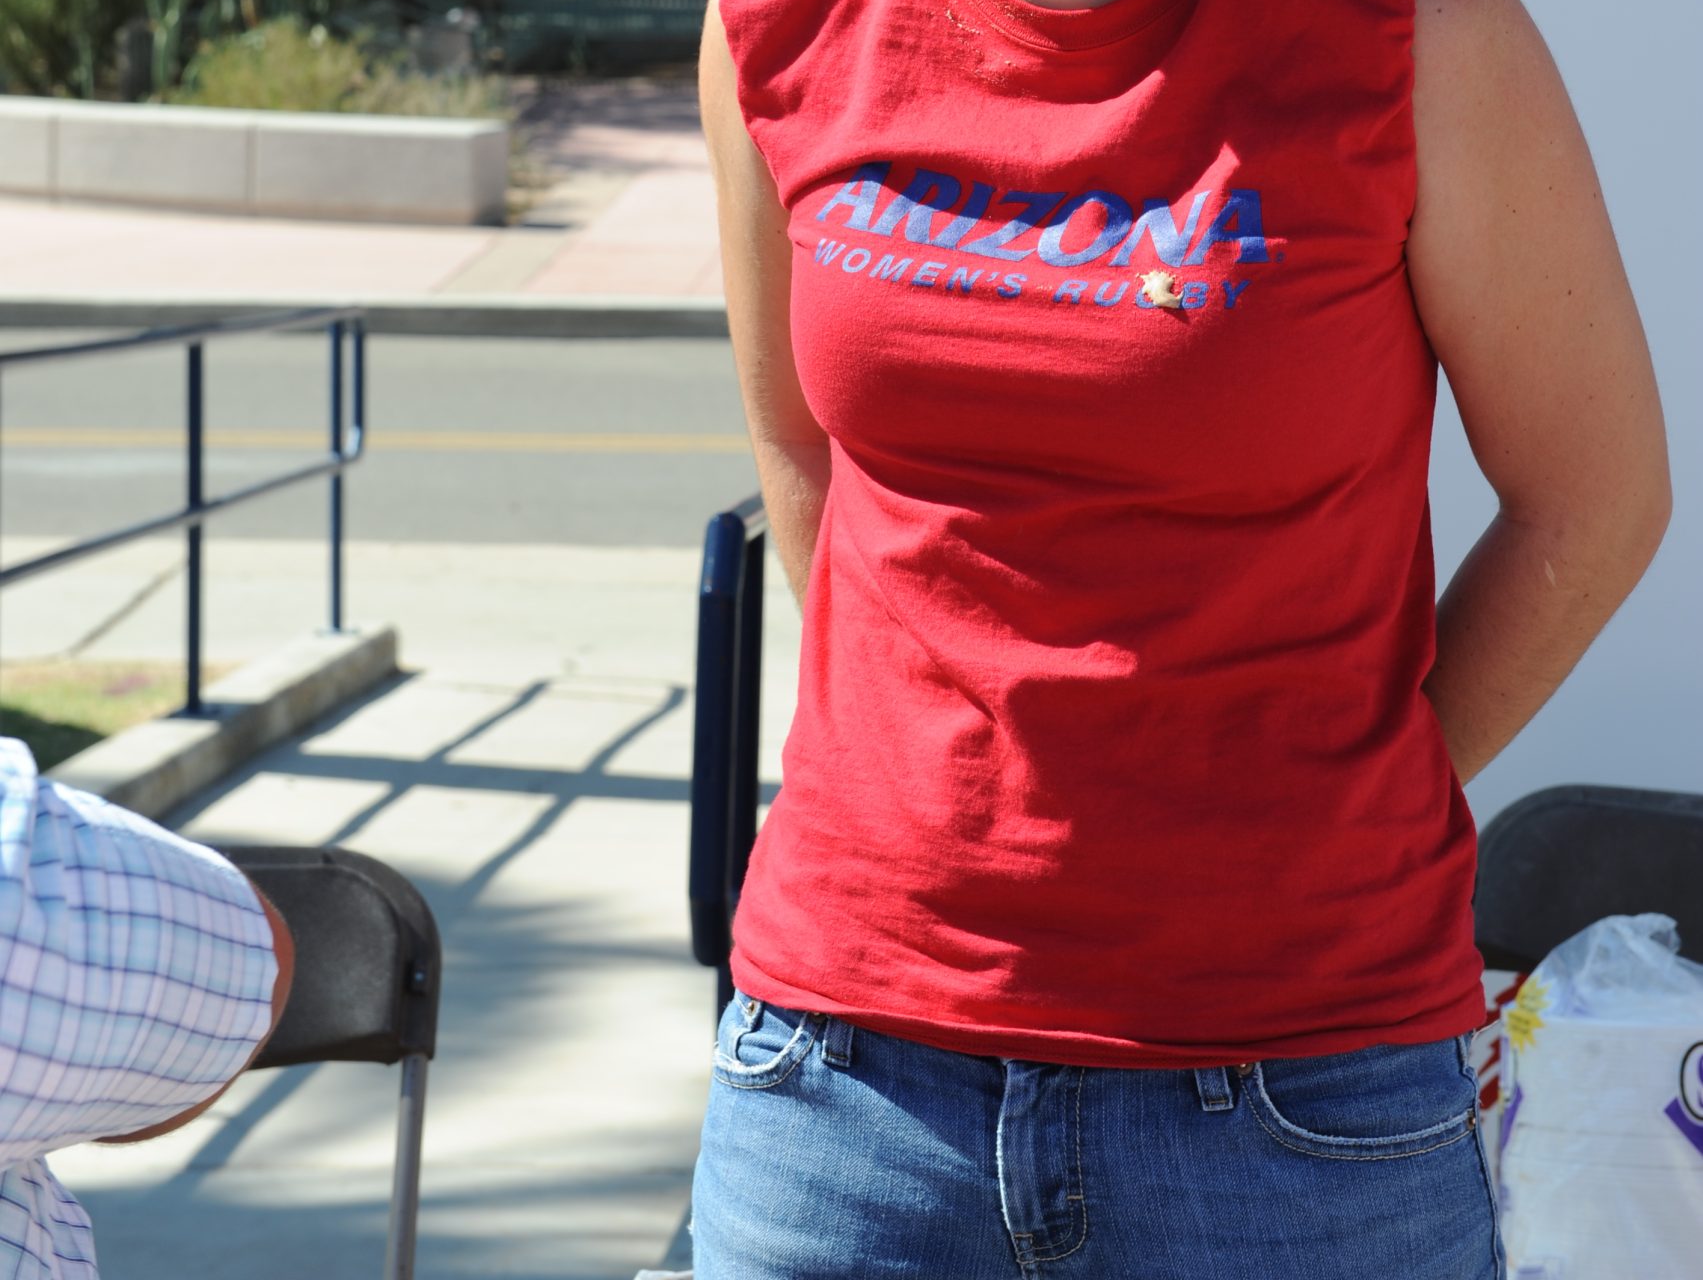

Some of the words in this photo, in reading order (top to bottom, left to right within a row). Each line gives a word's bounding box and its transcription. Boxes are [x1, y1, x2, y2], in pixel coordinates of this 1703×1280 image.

[815, 160, 1269, 268] ARIZONA
[814, 238, 1028, 299] WOMEN'S
[1052, 279, 1251, 310] RUBY
